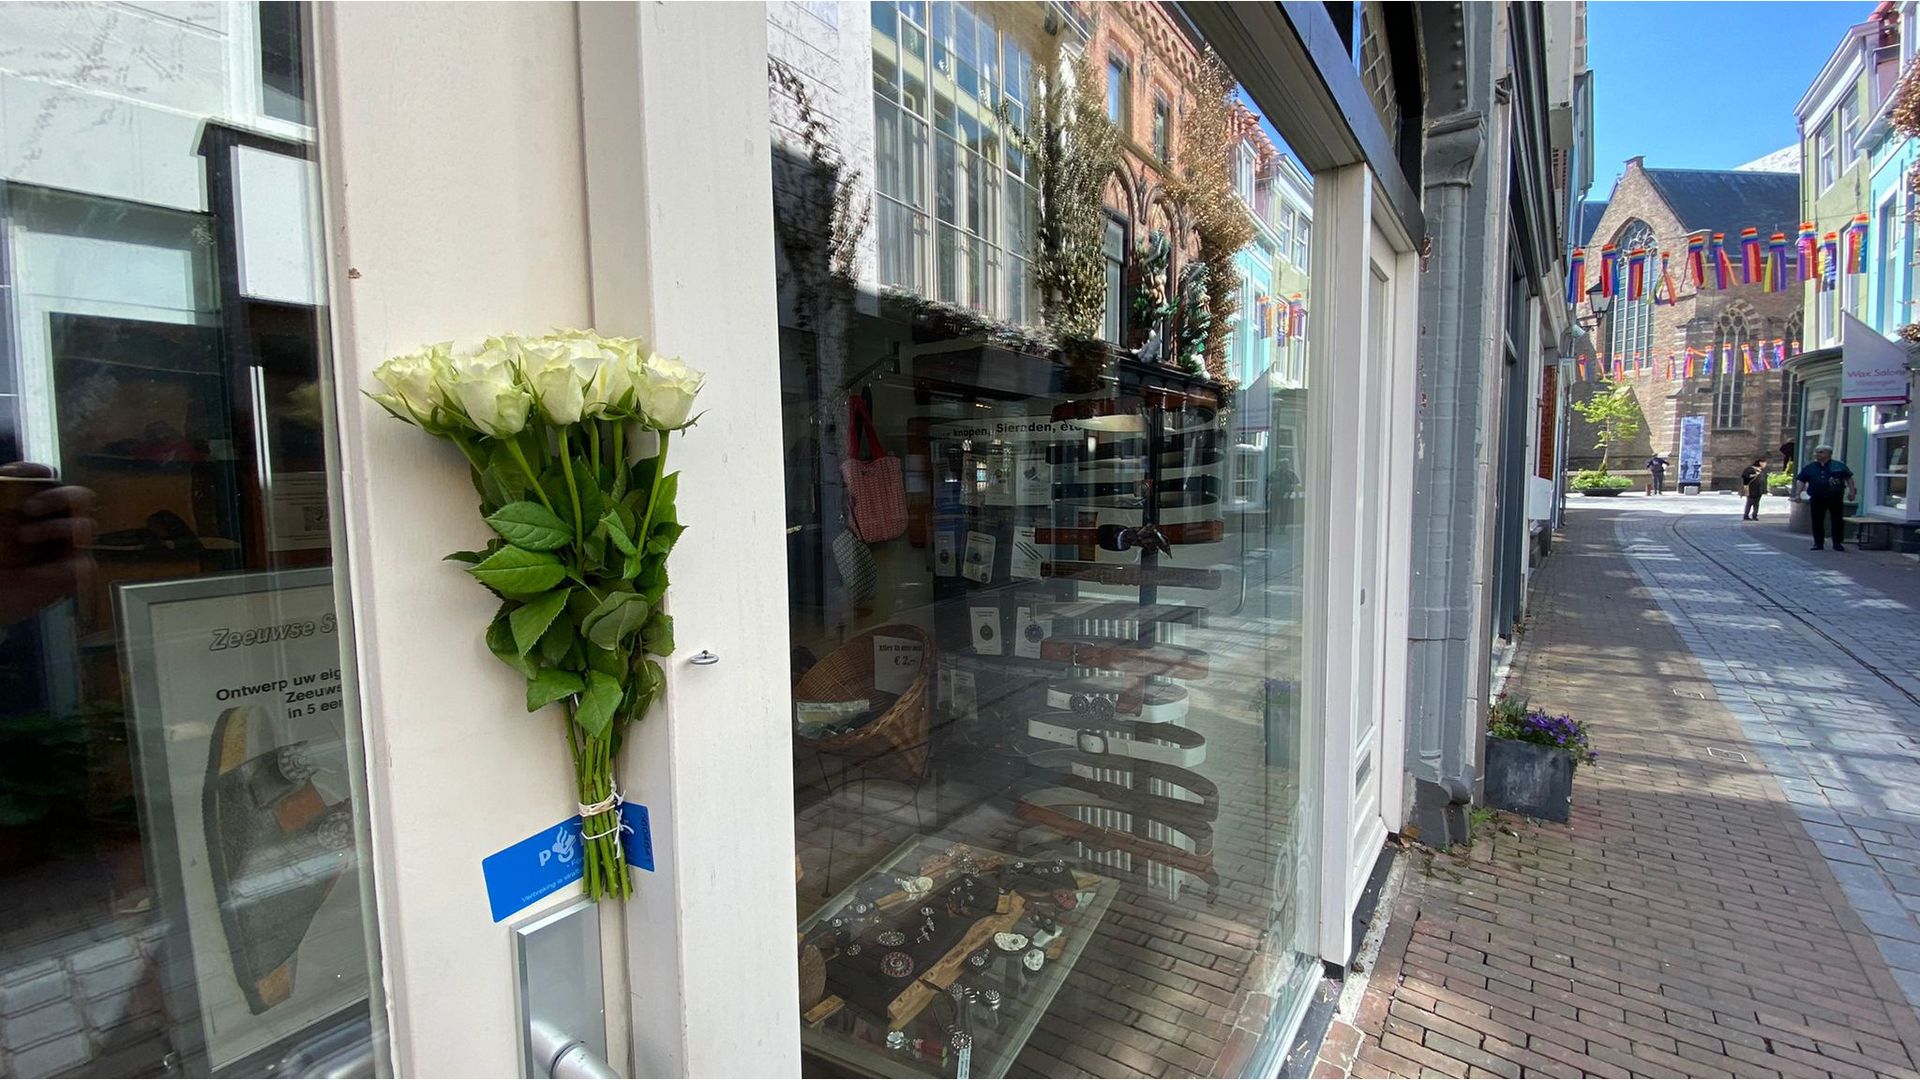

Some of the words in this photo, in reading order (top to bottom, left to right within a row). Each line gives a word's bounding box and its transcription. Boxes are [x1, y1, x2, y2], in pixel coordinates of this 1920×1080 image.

[209, 621, 315, 651] Zeeuwse
[320, 613, 337, 633] S
[216, 680, 288, 701] Ontwerp
[293, 674, 316, 687] uw
[288, 708, 302, 719] in
[307, 703, 316, 715] 5
